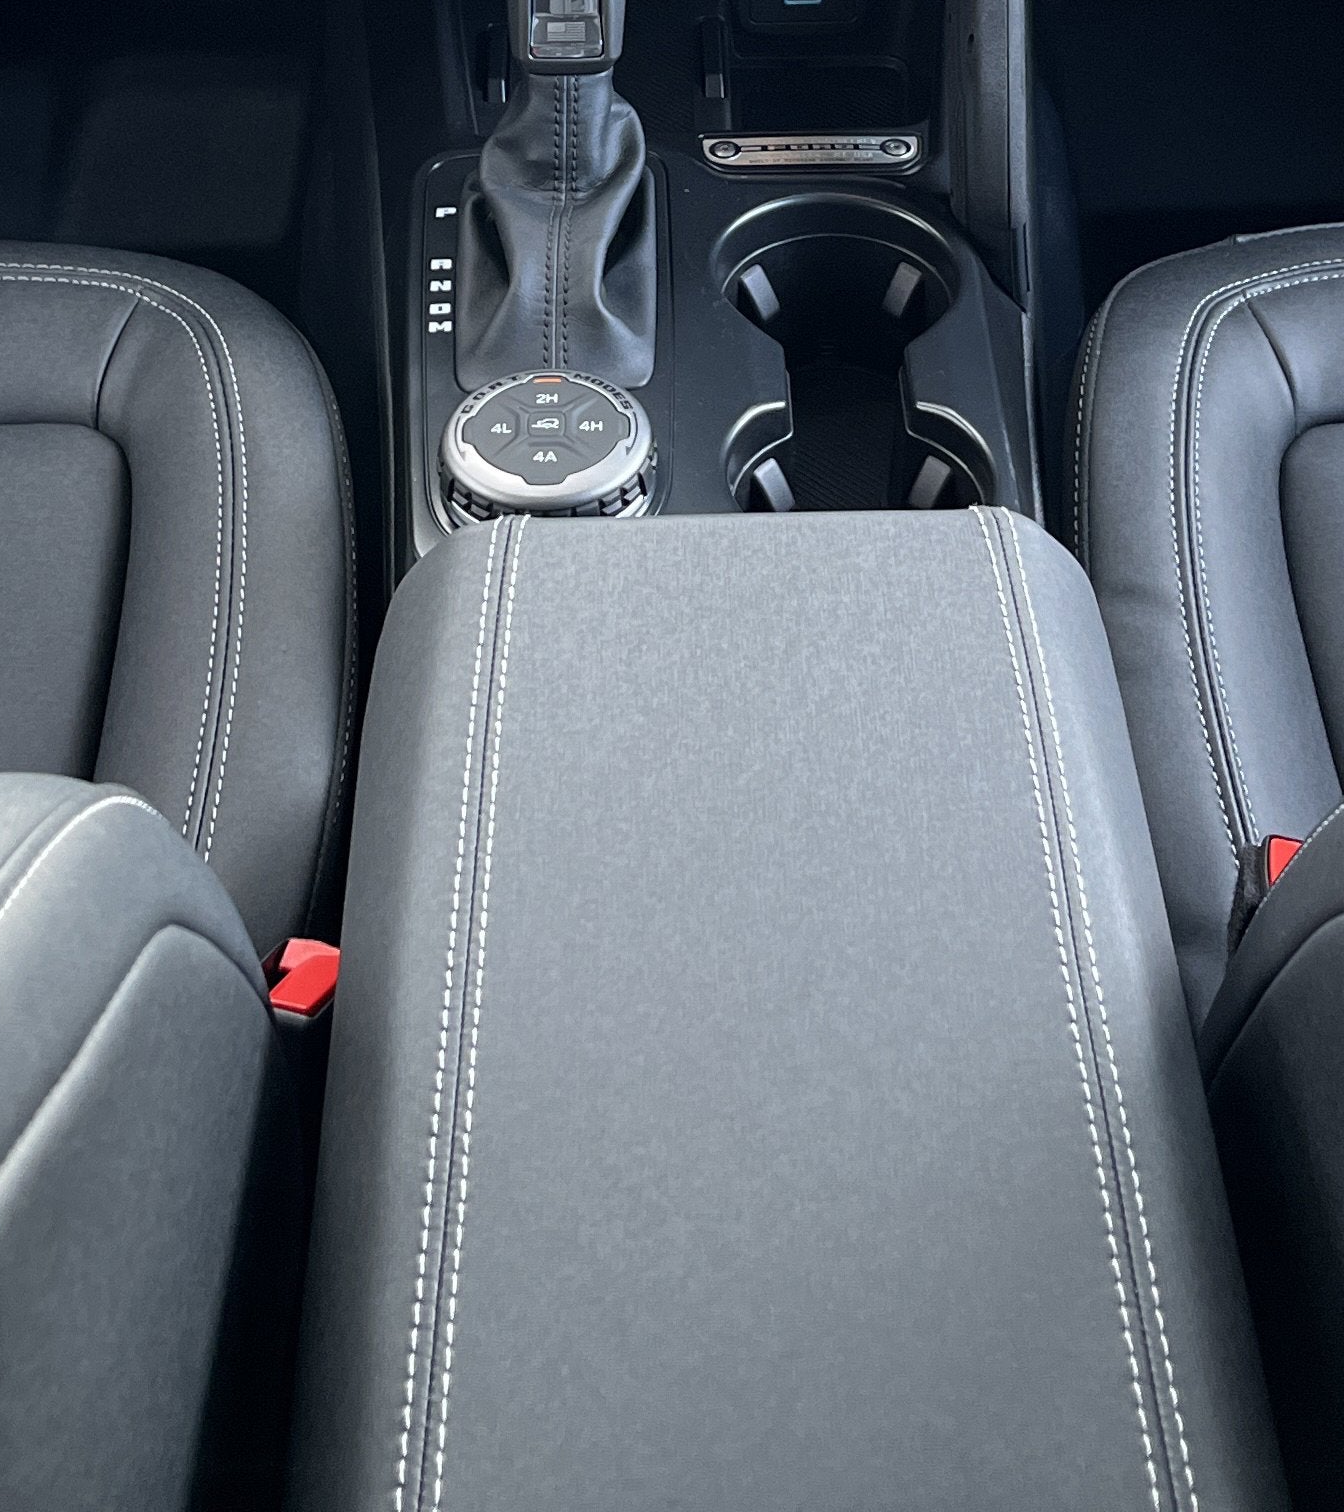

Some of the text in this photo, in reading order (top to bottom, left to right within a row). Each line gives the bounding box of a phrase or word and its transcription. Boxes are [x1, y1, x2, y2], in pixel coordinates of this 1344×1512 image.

[435, 207, 456, 218] P
[430, 258, 452, 270] R
[430, 280, 452, 292] N
[429, 321, 452, 333] M
[574, 373, 633, 410] MODES
[536, 394, 558, 404] 2H
[491, 423, 512, 434] 4L
[579, 421, 603, 432] 4H
[533, 451, 557, 463] 4A
